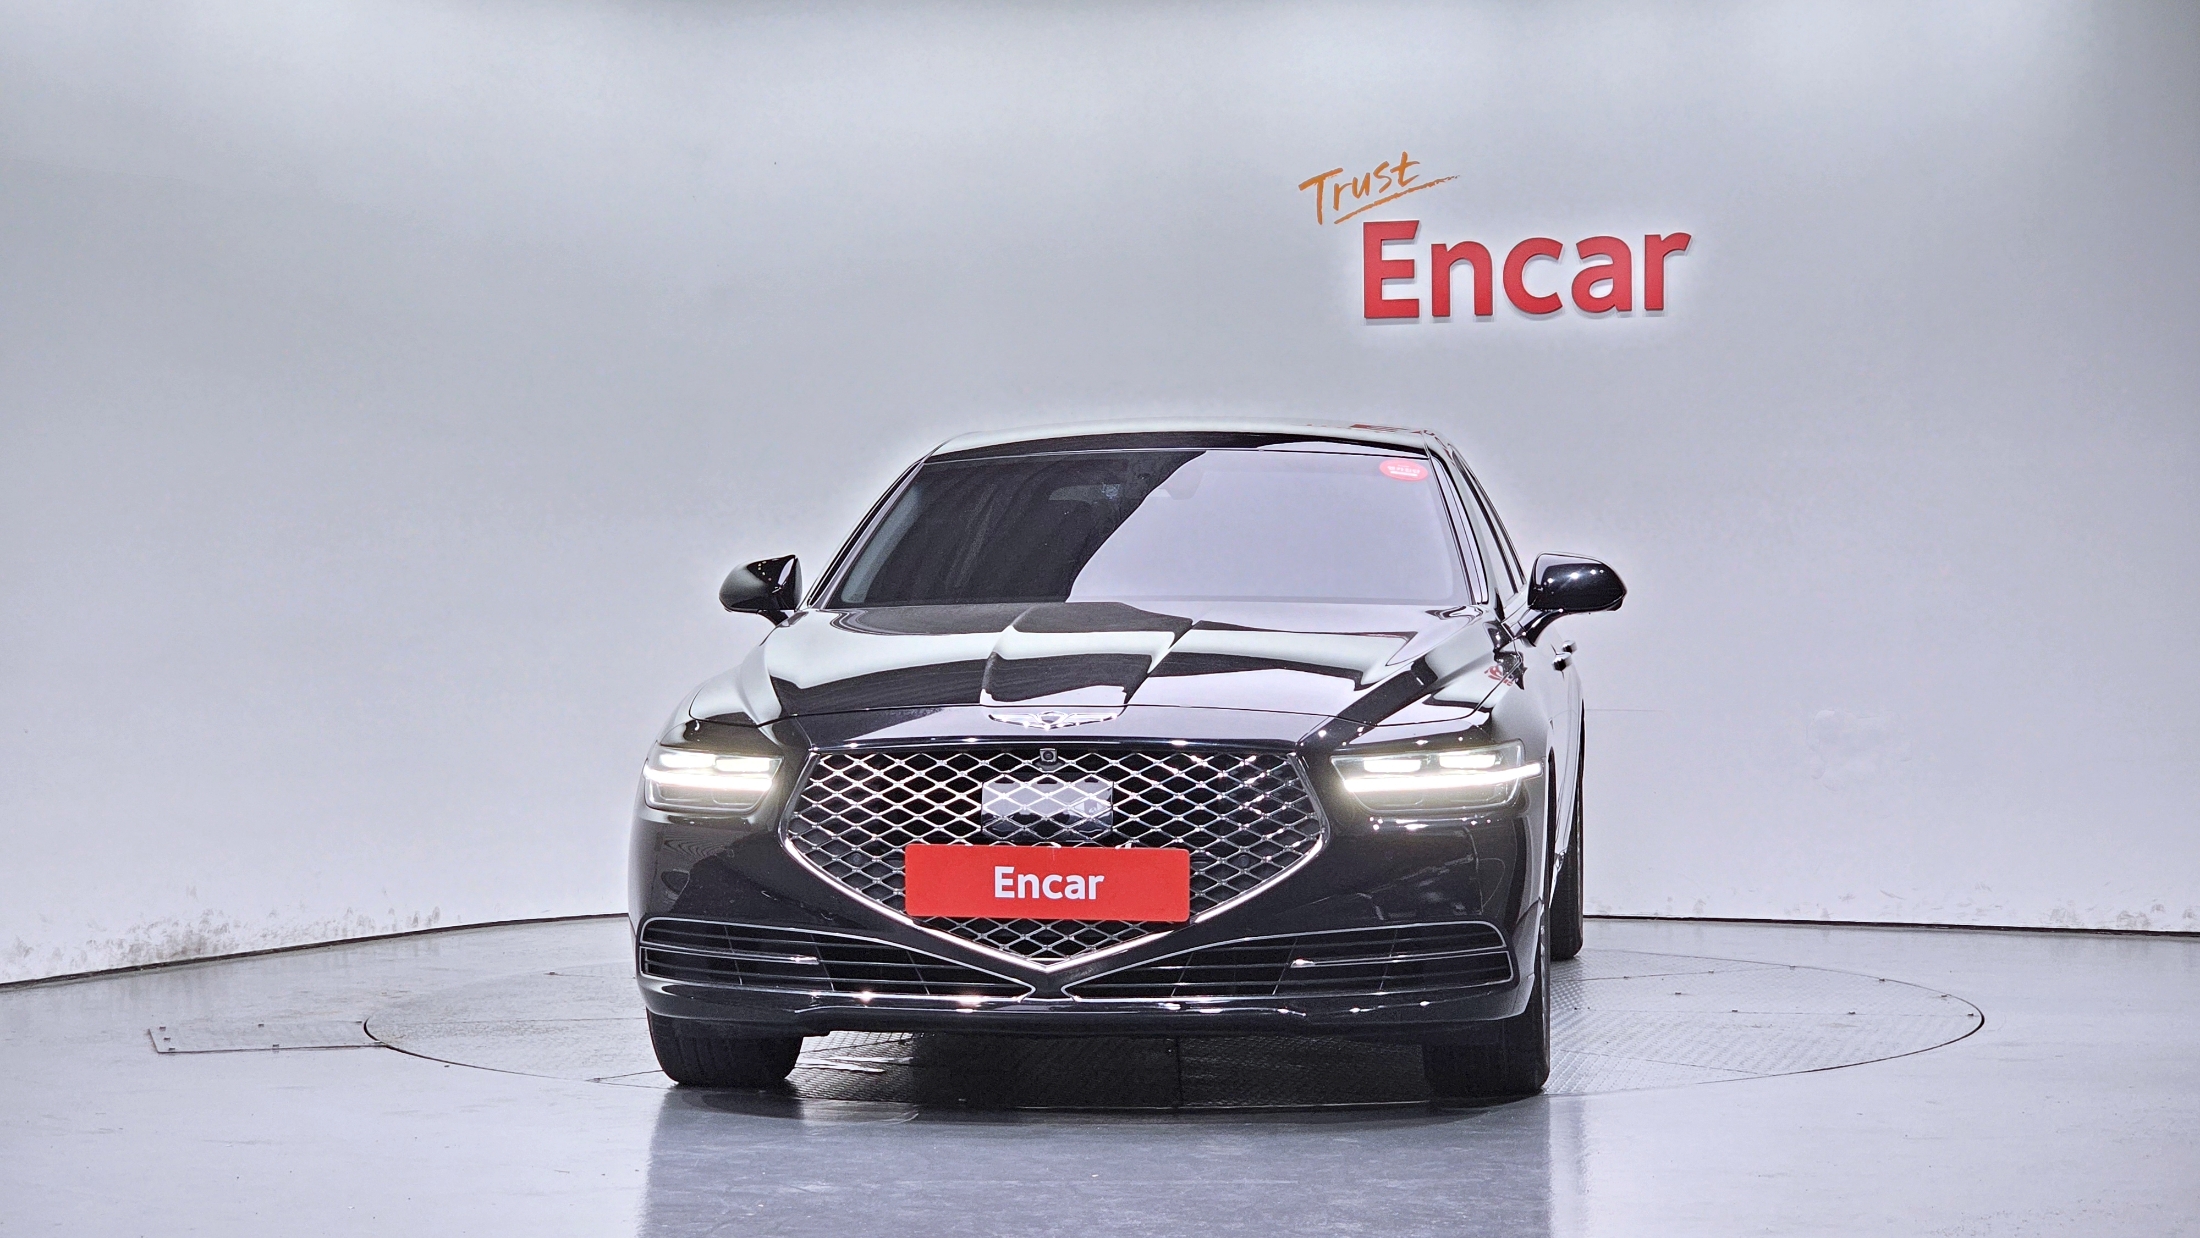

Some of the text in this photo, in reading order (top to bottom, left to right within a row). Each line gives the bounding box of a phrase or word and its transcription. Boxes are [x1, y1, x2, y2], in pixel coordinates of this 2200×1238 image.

[1298, 151, 1421, 225] Trust
[1363, 219, 1692, 319] Encar
[994, 866, 1105, 900] Encar
